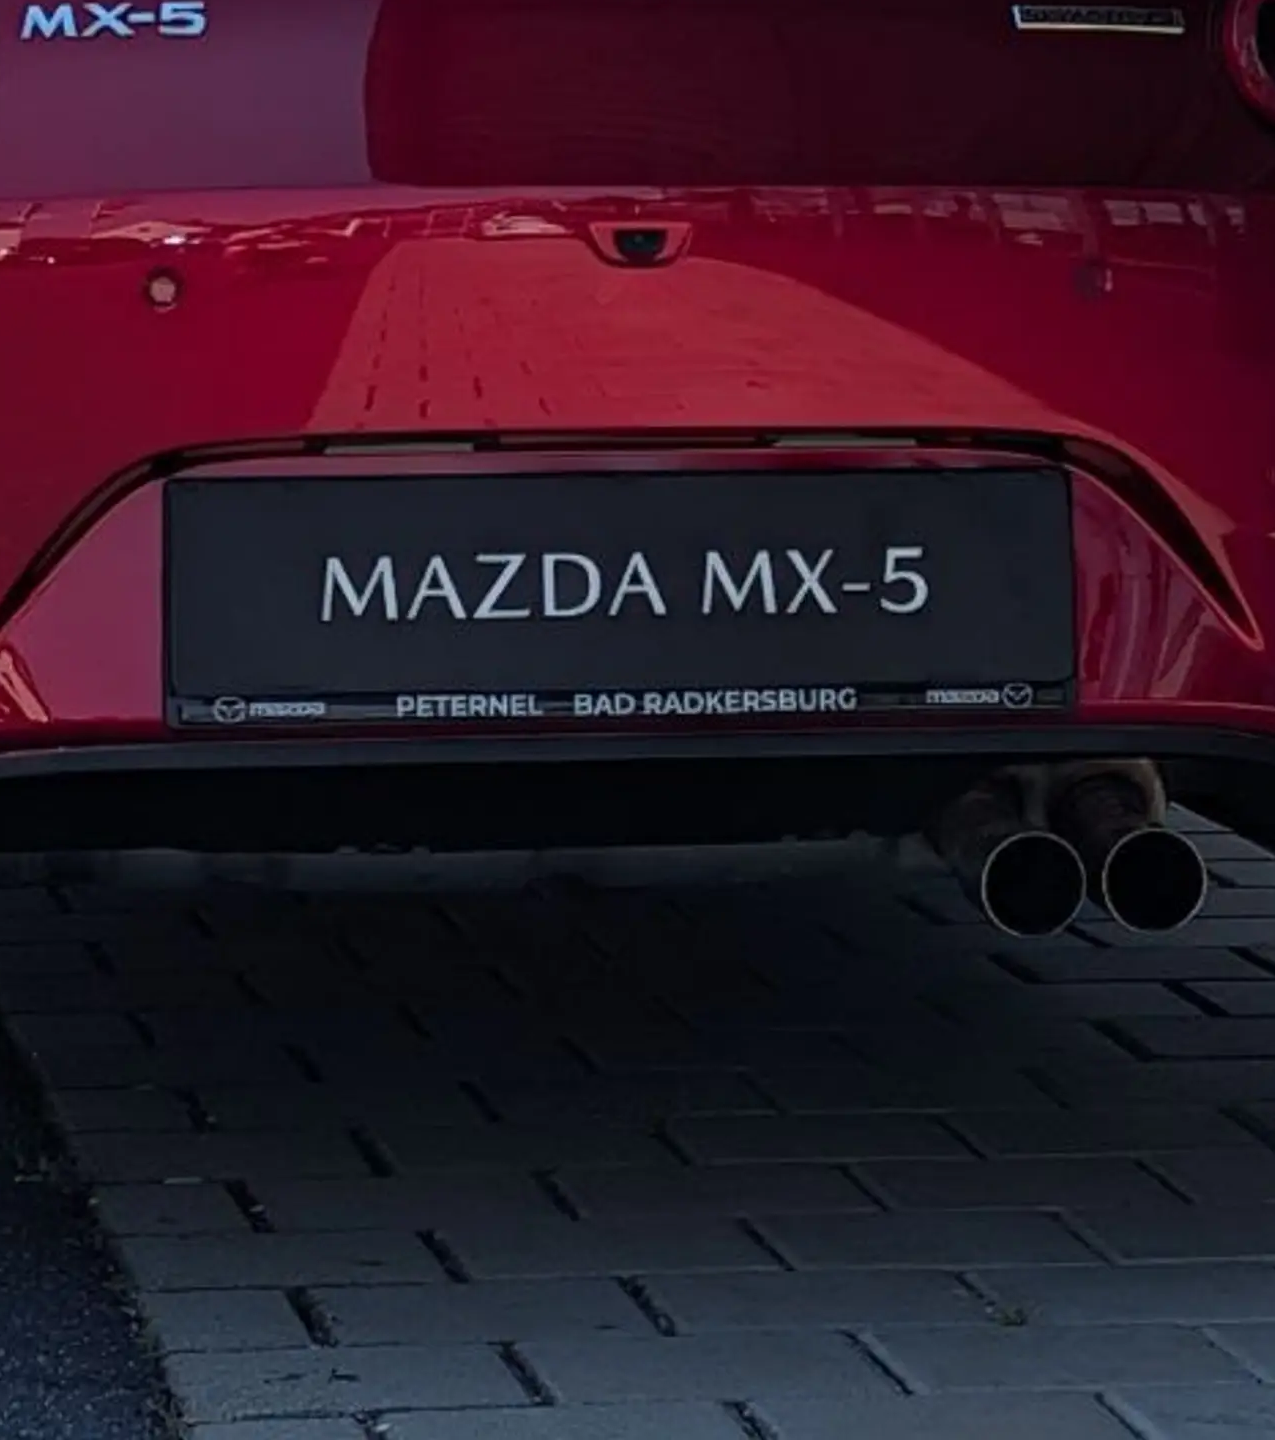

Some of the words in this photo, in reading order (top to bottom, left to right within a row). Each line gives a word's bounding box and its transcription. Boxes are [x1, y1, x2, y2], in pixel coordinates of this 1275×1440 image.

[20, 0, 206, 40] MX-5
[320, 551, 667, 621] MAZDA
[701, 546, 930, 615] MX-5
[395, 693, 544, 719] PETERNEL
[572, 692, 635, 716] BAD
[642, 687, 858, 716] RADKERSBURG
